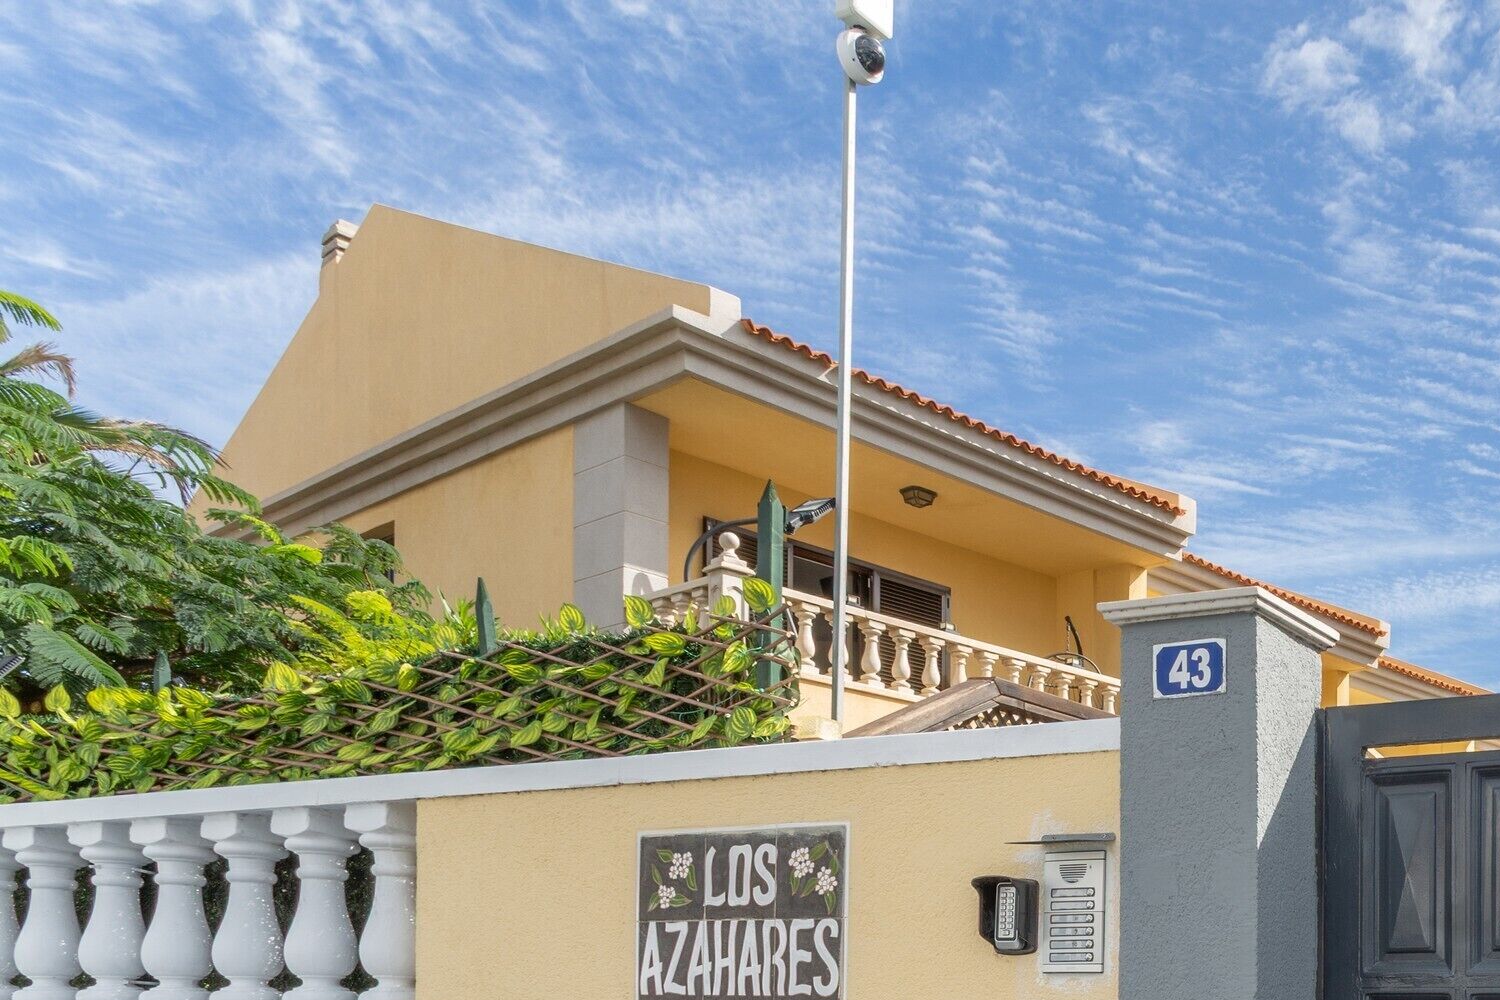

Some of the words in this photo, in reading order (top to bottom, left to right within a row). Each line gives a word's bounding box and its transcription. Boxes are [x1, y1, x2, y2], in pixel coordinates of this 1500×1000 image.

[1168, 647, 1212, 690] 43
[703, 843, 779, 907] LOS
[640, 918, 840, 997] AZAHARES
